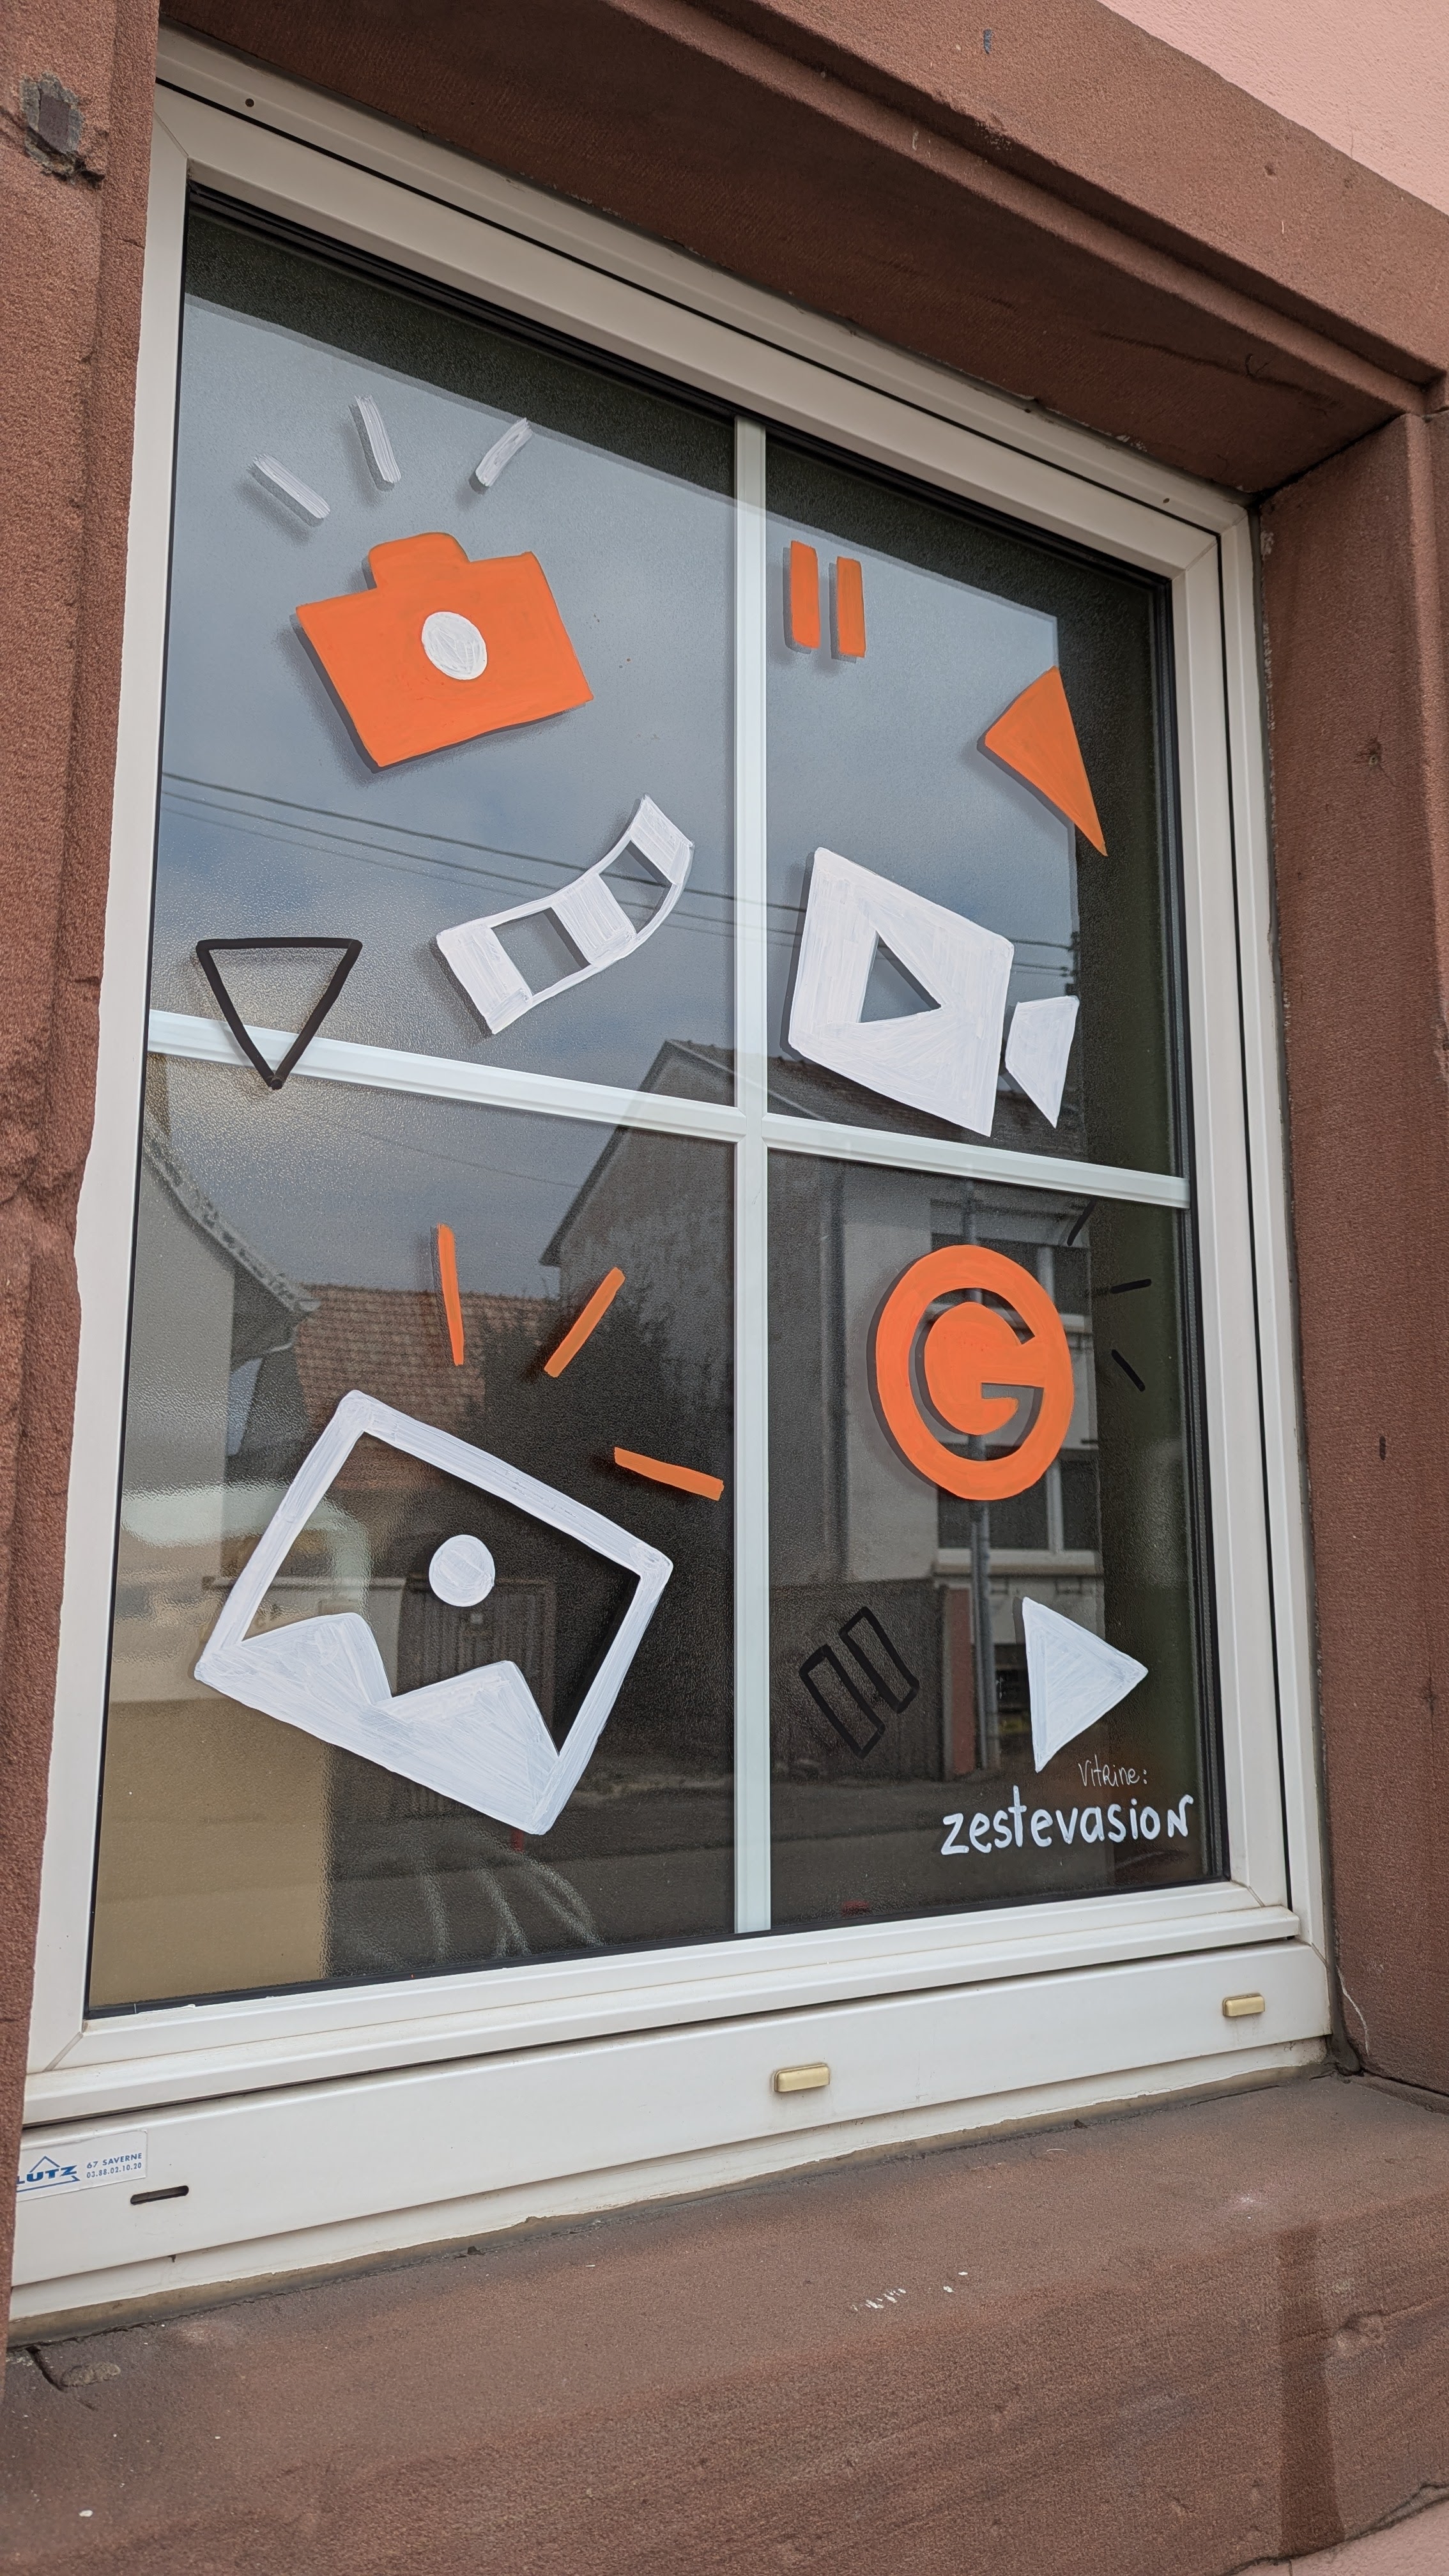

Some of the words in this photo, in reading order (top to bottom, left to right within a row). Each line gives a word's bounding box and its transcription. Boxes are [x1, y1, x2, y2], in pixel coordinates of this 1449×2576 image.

[87, 2161, 98, 2169] 67
[102, 2152, 142, 2166] SAVERNE
[86, 2162, 142, 2179] 03.88.02.10.20
